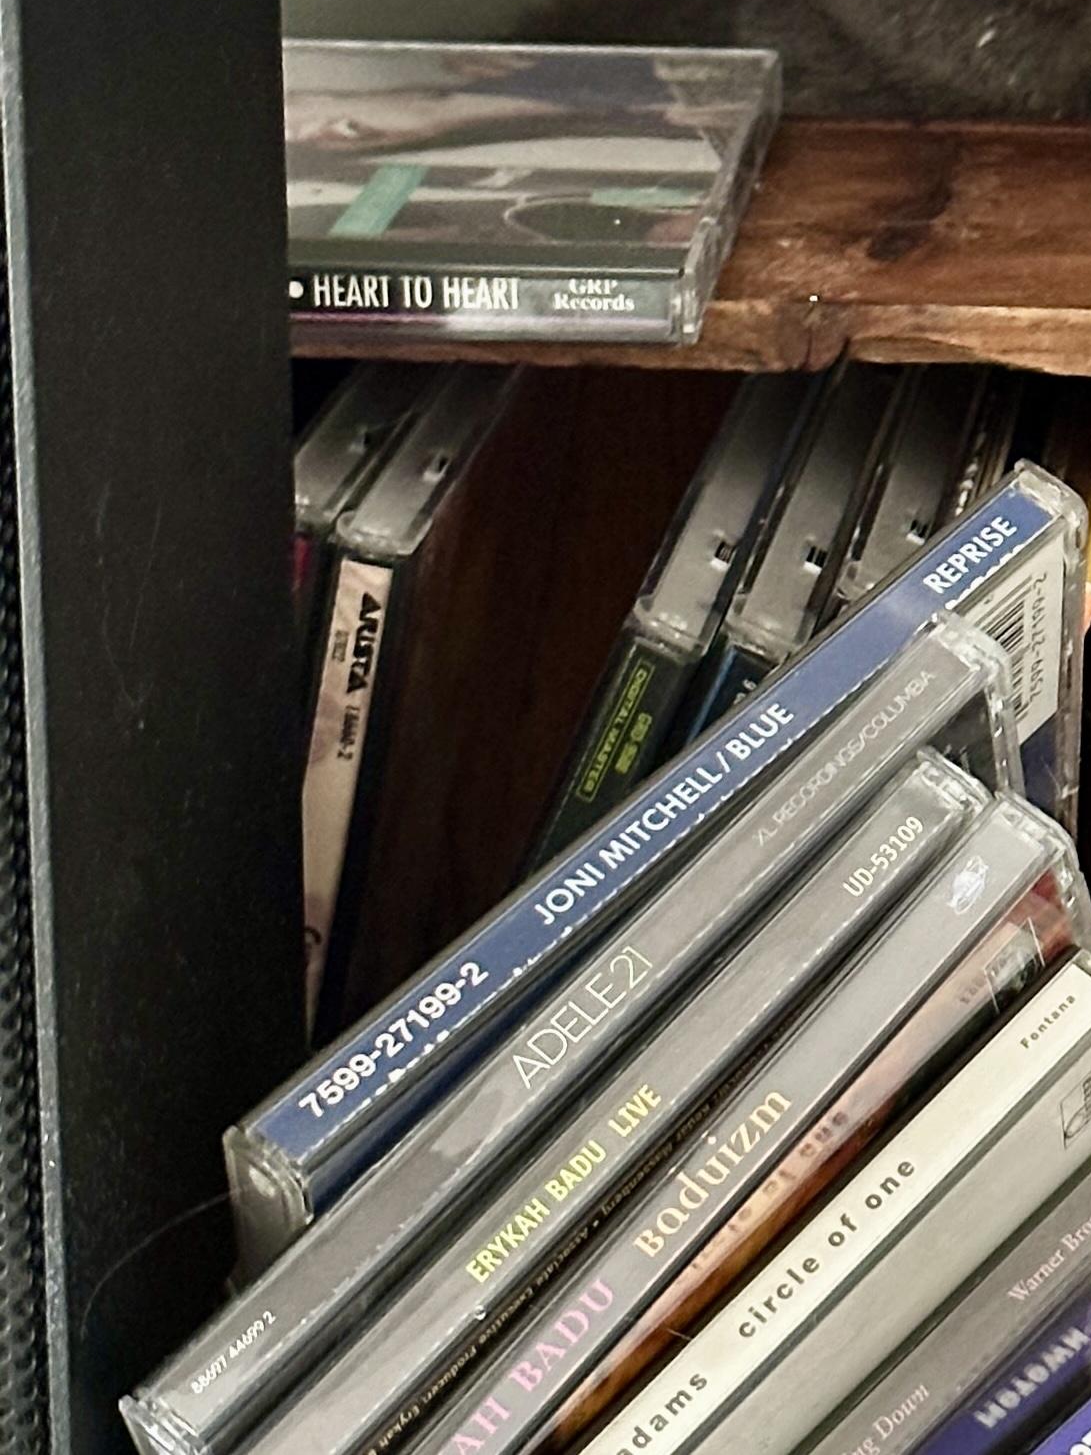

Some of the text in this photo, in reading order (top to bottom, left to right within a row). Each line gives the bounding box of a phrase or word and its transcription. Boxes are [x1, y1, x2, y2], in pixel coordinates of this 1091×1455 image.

[312, 274, 520, 310] HEART TO HEART
[553, 292, 635, 312] Records
[568, 277, 618, 295] GRP
[922, 511, 1018, 598] REPRISE
[346, 591, 382, 696] ARISTA
[612, 667, 649, 727] DIGITAL
[582, 726, 621, 793] MASTER
[750, 819, 779, 848] XL
[841, 812, 926, 899] UD-53109
[297, 954, 490, 1123] 7599-27199-2
[531, 858, 606, 927] JONI
[597, 759, 723, 871] MITCHELL
[725, 698, 795, 762] BLUE
[503, 969, 626, 1090] ADELE
[607, 942, 654, 989] 21
[1019, 991, 1076, 1050] Fontana
[464, 1082, 663, 1284] ERYKAH BADU LIVE
[507, 1275, 619, 1395] BADU
[621, 1076, 792, 1260] Baduizm
[732, 1249, 821, 1341] circle
[822, 1212, 859, 1250] of
[861, 1157, 916, 1213] one
[1006, 1244, 1067, 1306] Warner
[262, 1309, 276, 1324] 2
[375, 1402, 421, 1449] Erykah
[870, 1379, 932, 1441] Down
